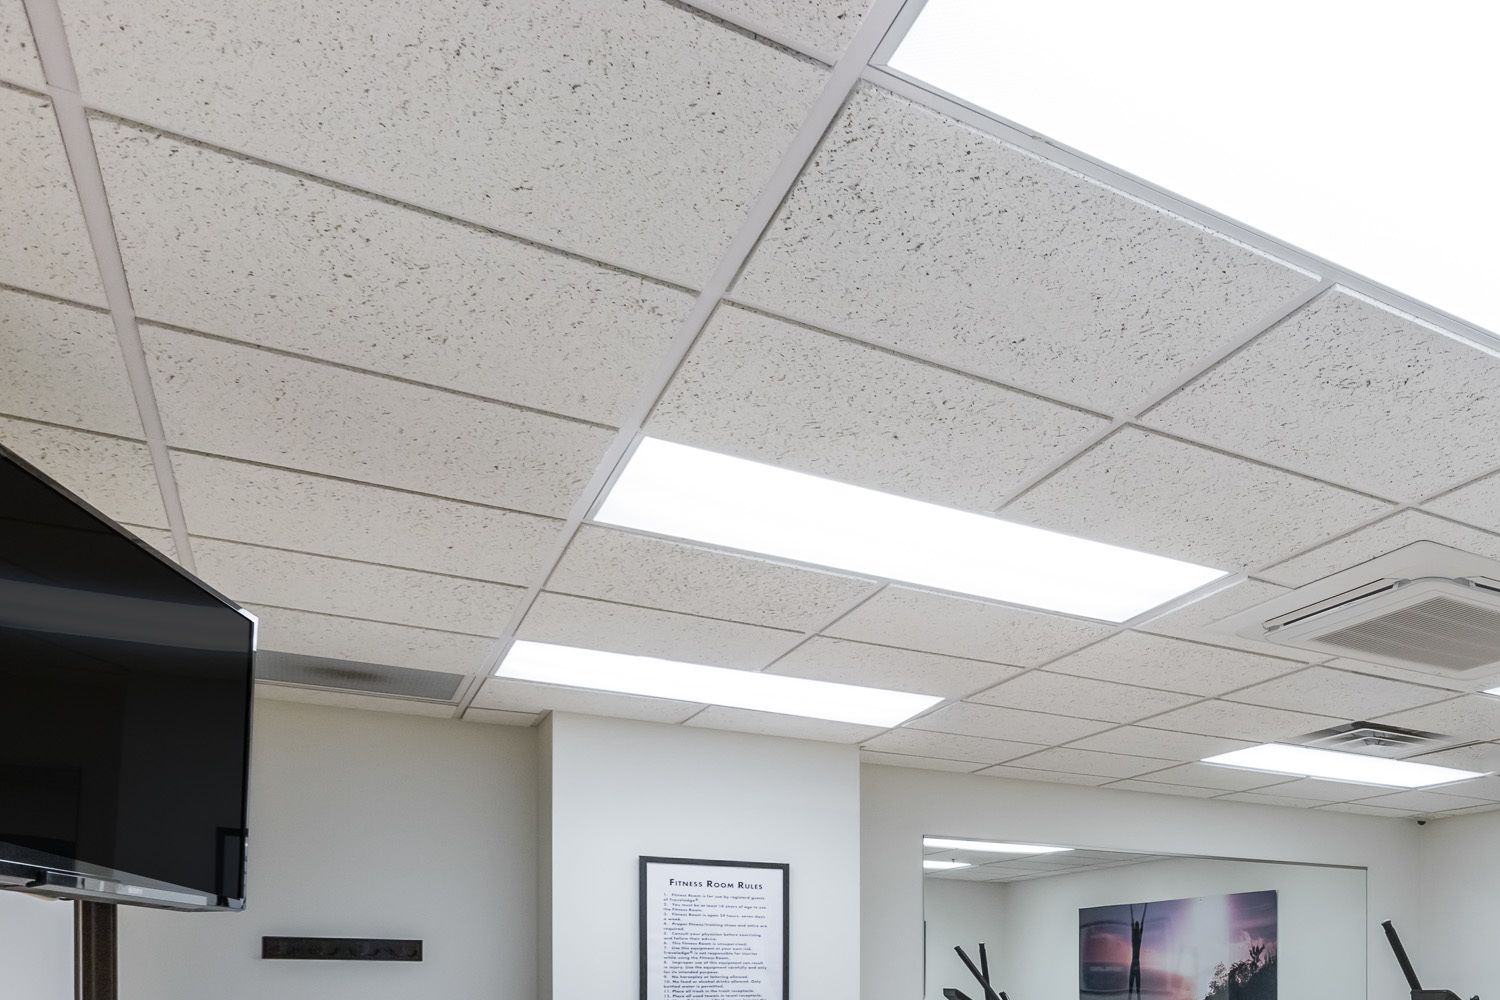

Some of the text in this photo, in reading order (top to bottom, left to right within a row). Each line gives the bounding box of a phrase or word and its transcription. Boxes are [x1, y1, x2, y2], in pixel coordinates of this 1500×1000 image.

[669, 878, 763, 890] FITNESS ROOM RULES
